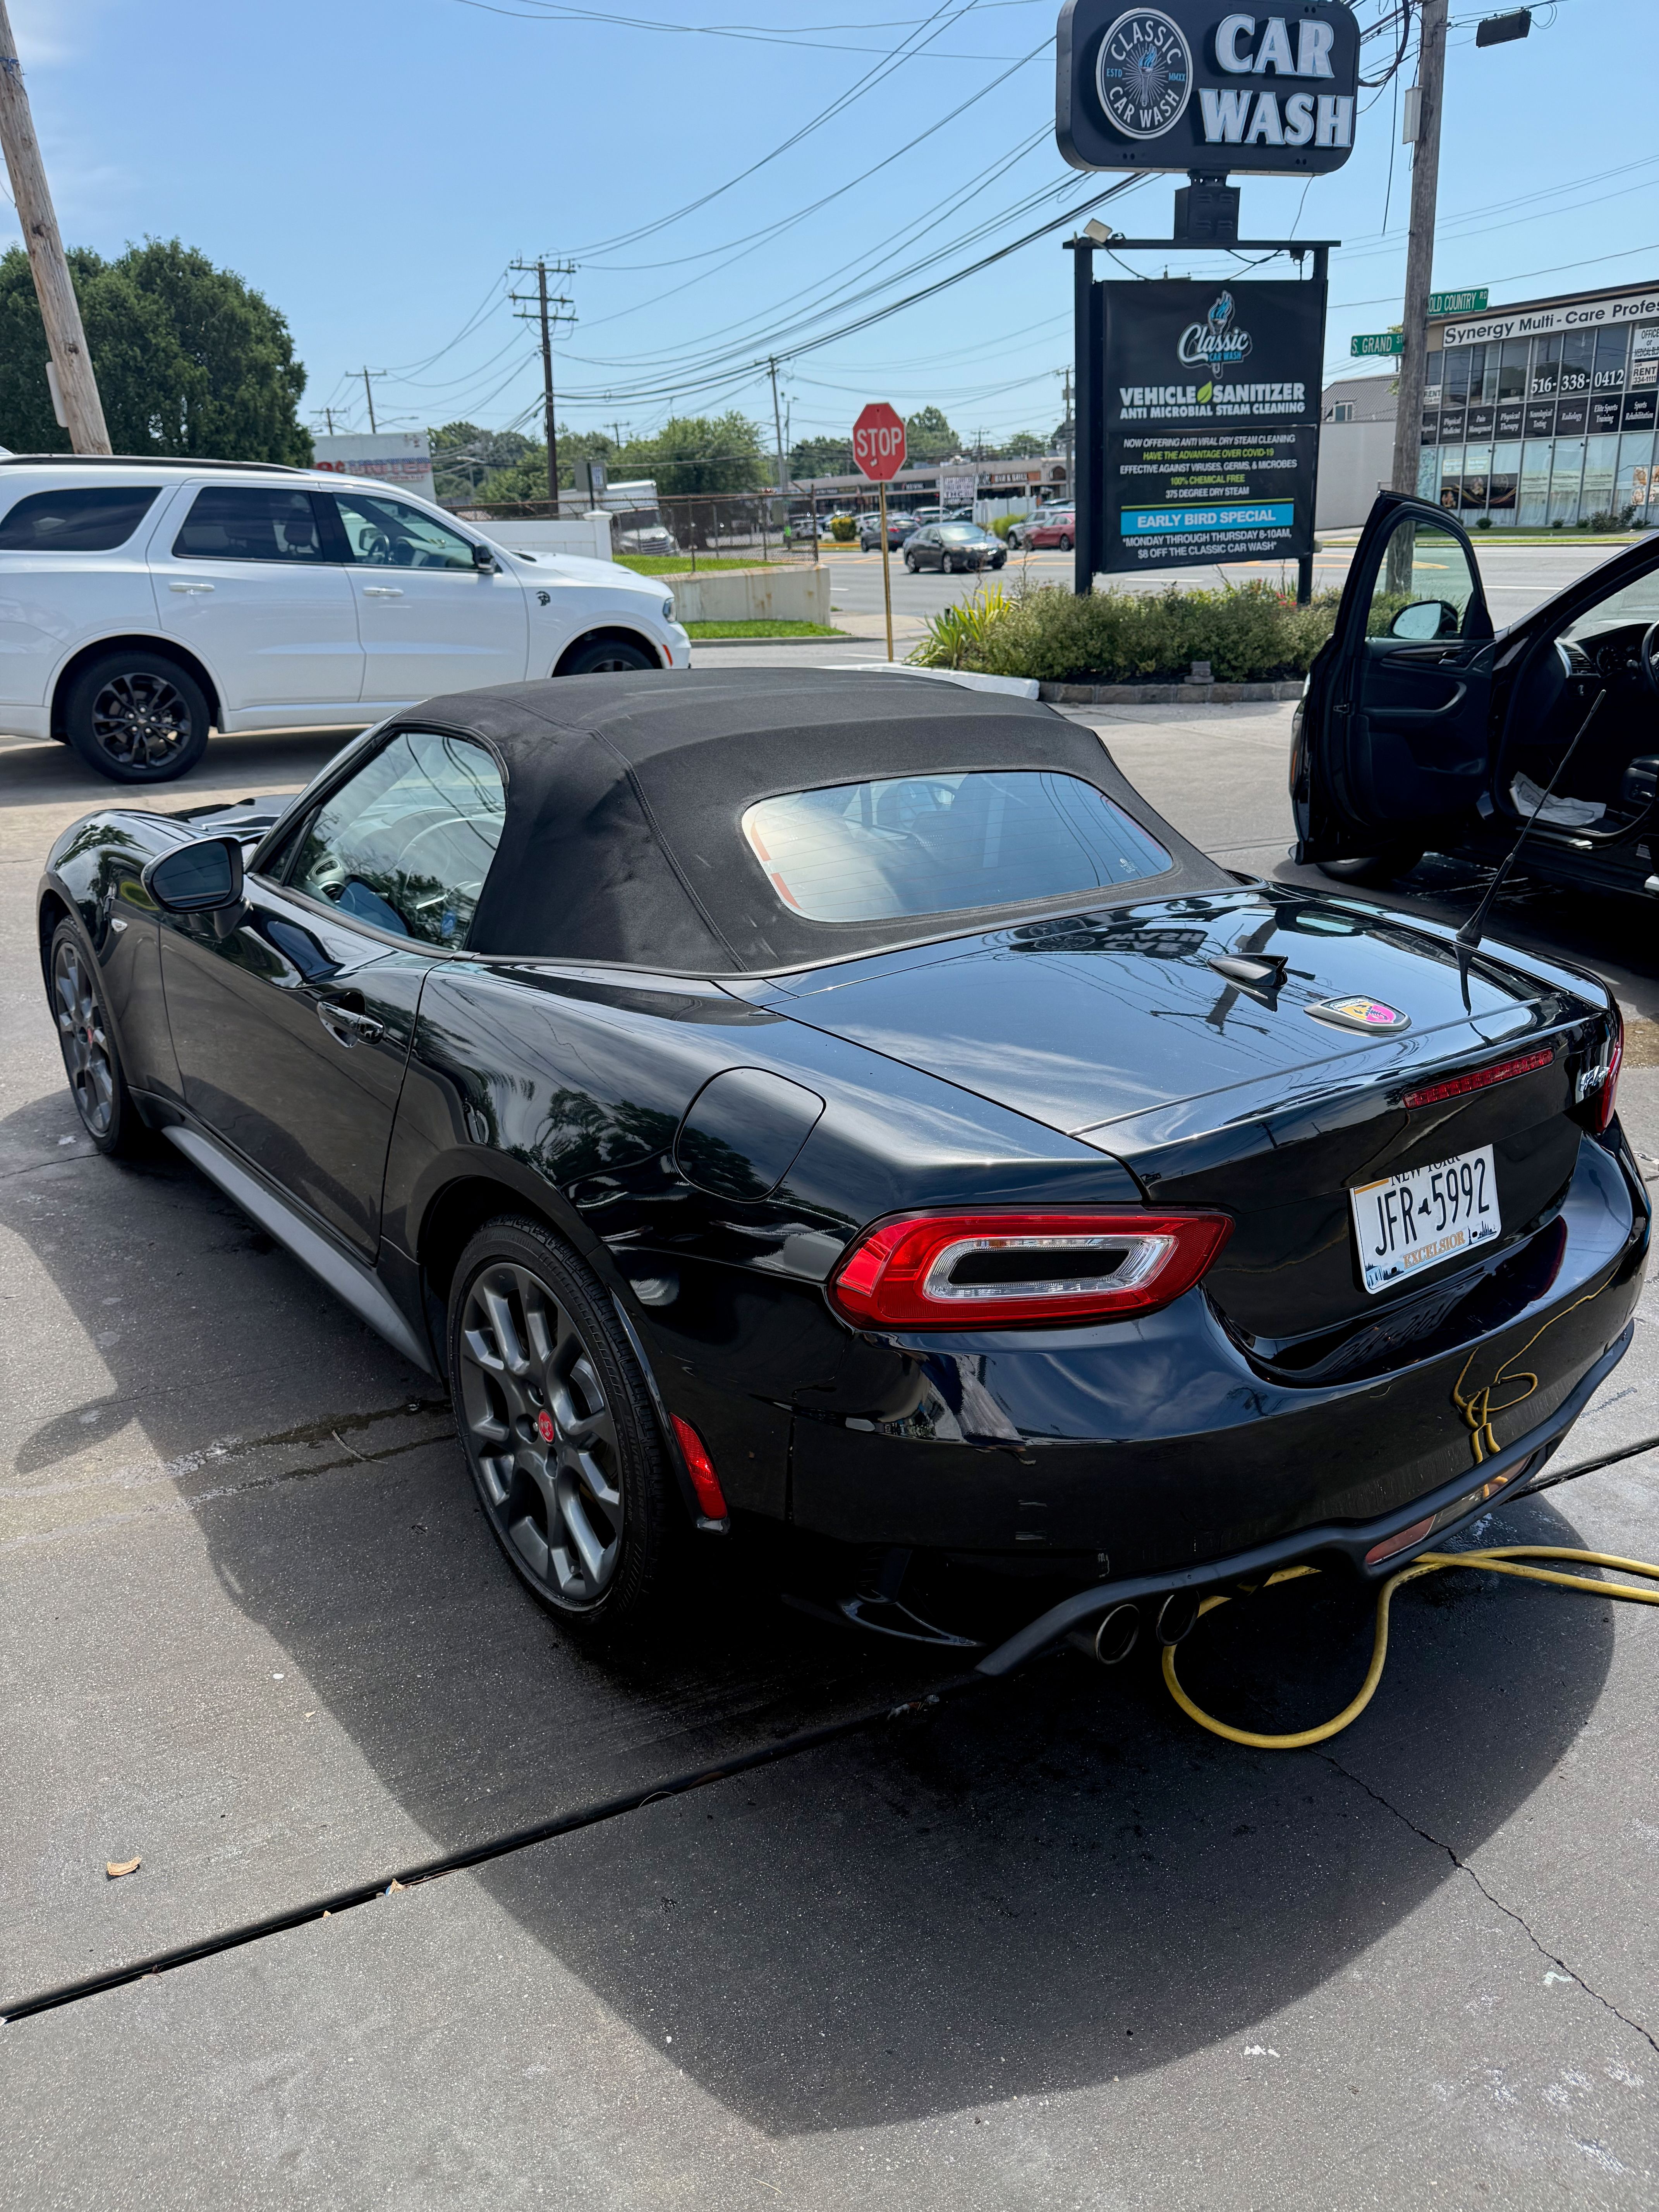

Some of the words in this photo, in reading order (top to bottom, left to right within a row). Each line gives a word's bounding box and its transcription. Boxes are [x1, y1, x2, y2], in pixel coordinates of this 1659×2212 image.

[1111, 21, 1181, 64] CLASSIC
[1215, 14, 1335, 77] CAR
[1106, 68, 1122, 77] ESTD
[1168, 72, 1185, 81] MMXX
[1109, 86, 1135, 123] CAR
[1140, 89, 1179, 127] WASH
[1198, 88, 1355, 148] WASH
[1429, 297, 1442, 313] OLD
[1444, 292, 1477, 311] COUNTRY
[1479, 291, 1487, 299] RD
[1445, 321, 1514, 344] Synergy
[1519, 314, 1554, 331] Multi
[1565, 309, 1605, 324] Care
[1178, 323, 1249, 362] Classic
[1352, 338, 1358, 354] S.
[1362, 336, 1393, 353] GRAND
[1209, 352, 1222, 361] CAR
[1223, 351, 1242, 360] WASH
[1633, 366, 1657, 376] RENT
[1531, 377, 1556, 393] 516-
[1561, 373, 1590, 391] 338-
[1594, 369, 1624, 387] 0412
[1120, 386, 1197, 406] VEHICLE
[1212, 383, 1305, 403] SANITIZER
[1120, 407, 1147, 419] ANTI
[1150, 404, 1213, 418] MICROBIAL
[1216, 404, 1250, 415] STEAM
[1253, 402, 1305, 414] CLEANING
[857, 427, 902, 457] STOP
[1123, 438, 1142, 448] NOW
[1143, 438, 1180, 447] OFFERING
[1180, 438, 1197, 447] ANTI
[1198, 437, 1218, 446] VIRAL
[1219, 436, 1234, 445] DRY
[1234, 436, 1257, 445] STEAM
[1258, 434, 1296, 444] CLEANING
[1143, 451, 1163, 460] HAVE
[1164, 451, 1178, 460] THE
[1178, 450, 1221, 459] ADVANTAGE
[1222, 449, 1242, 458] OVER
[1242, 448, 1274, 457] COVID-19
[1120, 464, 1159, 474] EFFECTIVE
[1159, 464, 1190, 473] AGAINST
[1191, 462, 1223, 472] VIRUSES,
[1223, 461, 1251, 471] GERMS,
[1252, 461, 1257, 470] &
[1258, 459, 1297, 469] MICROBES
[1171, 477, 1188, 486] 100%
[1189, 475, 1225, 484] CHEMICAL
[1226, 474, 1245, 483] FREE
[1166, 489, 1178, 499] 375
[1178, 488, 1208, 498] DEGREE
[1209, 488, 1224, 496] DRY
[1224, 486, 1250, 496] STEAM
[1137, 514, 1182, 528] EARLY
[1184, 512, 1217, 526] BIRD
[1220, 510, 1276, 523] SPECIAL
[1165, 532, 1210, 544] THROUGH
[1211, 530, 1258, 542] THURSDAY
[1138, 549, 1149, 559] $8
[1149, 548, 1168, 558] OFF
[1169, 546, 1188, 556] THE
[1188, 544, 1226, 555] CLASSIC
[1227, 543, 1247, 553] CAR
[1376, 1187, 1417, 1256] JFR
[1431, 1158, 1489, 1231] 5992
[1403, 1231, 1465, 1269] EXCELSIOR
